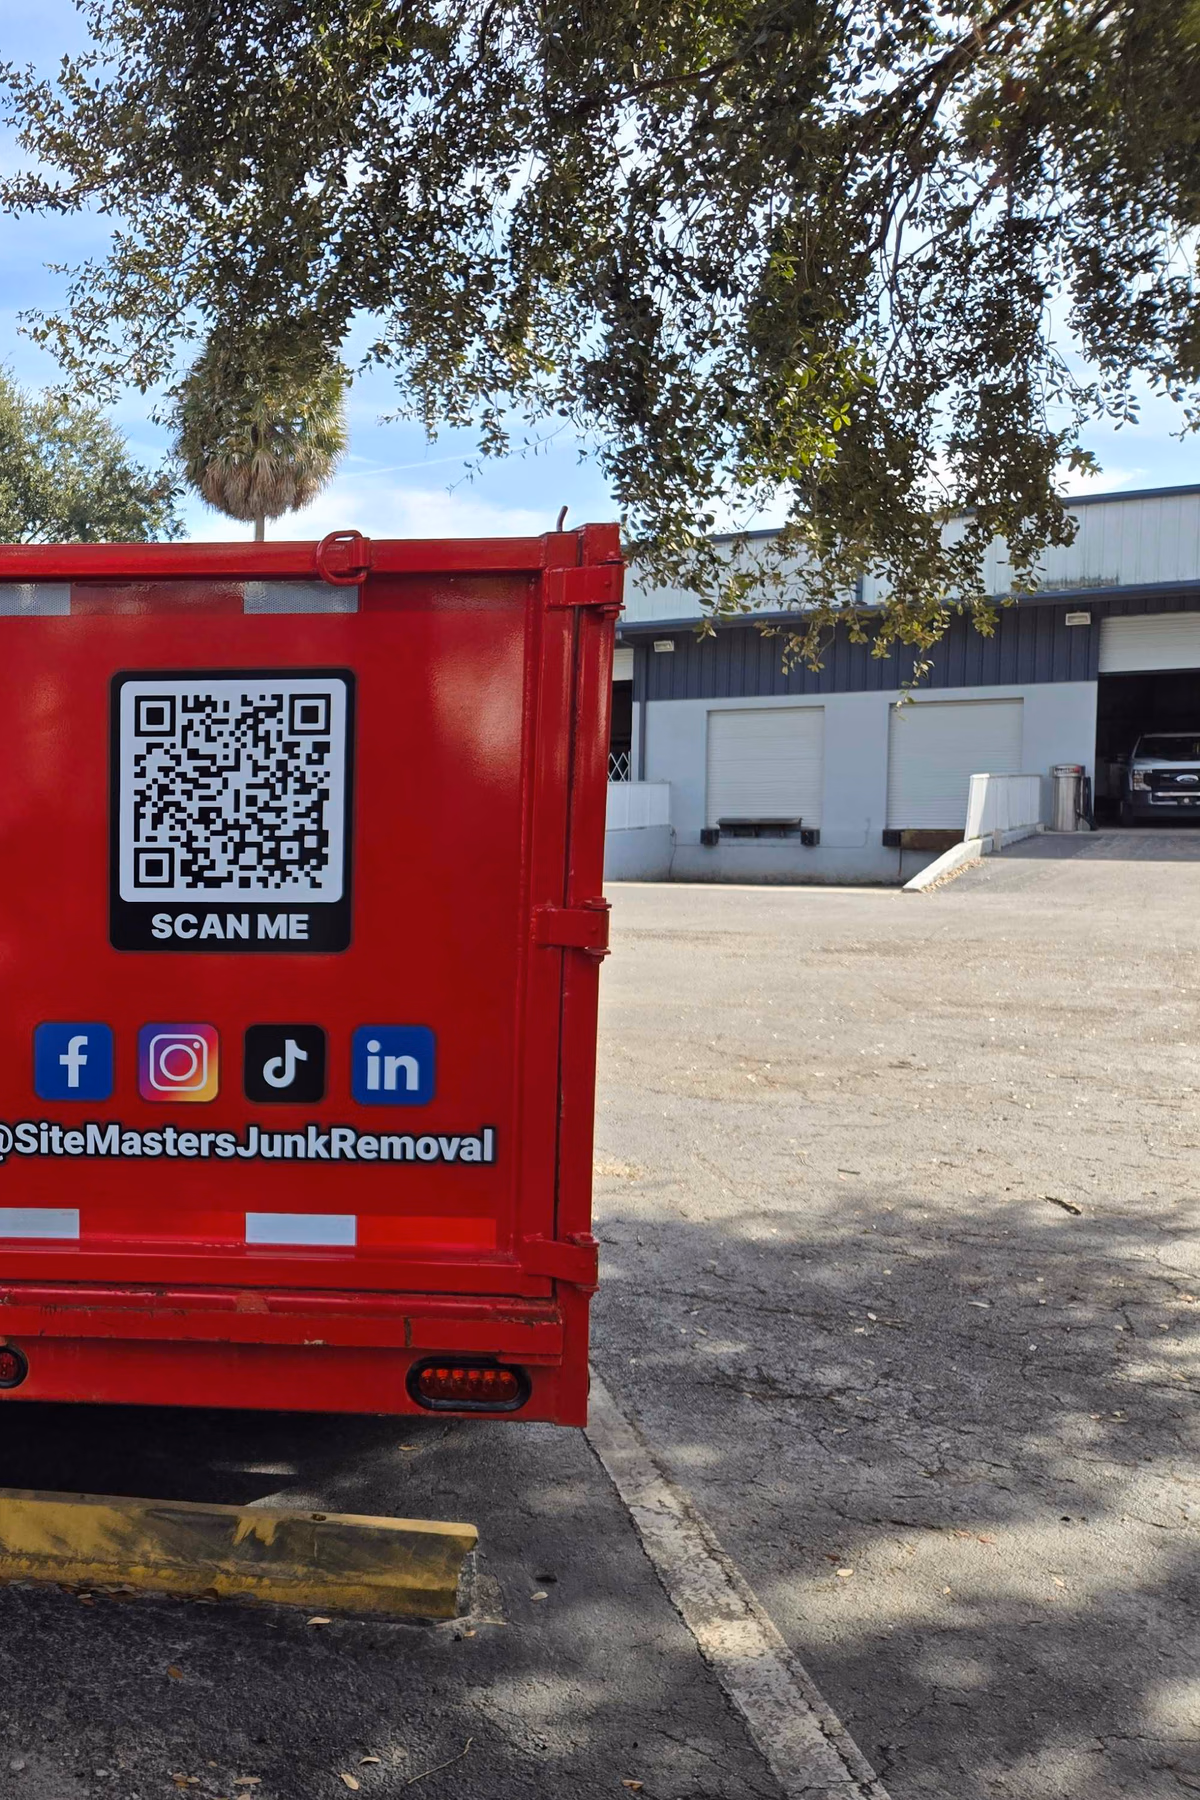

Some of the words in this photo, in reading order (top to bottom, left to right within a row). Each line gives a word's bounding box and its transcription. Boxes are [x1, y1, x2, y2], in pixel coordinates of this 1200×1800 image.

[151, 913, 249, 939] SCAN
[257, 914, 309, 939] ME
[366, 1039, 420, 1091] in
